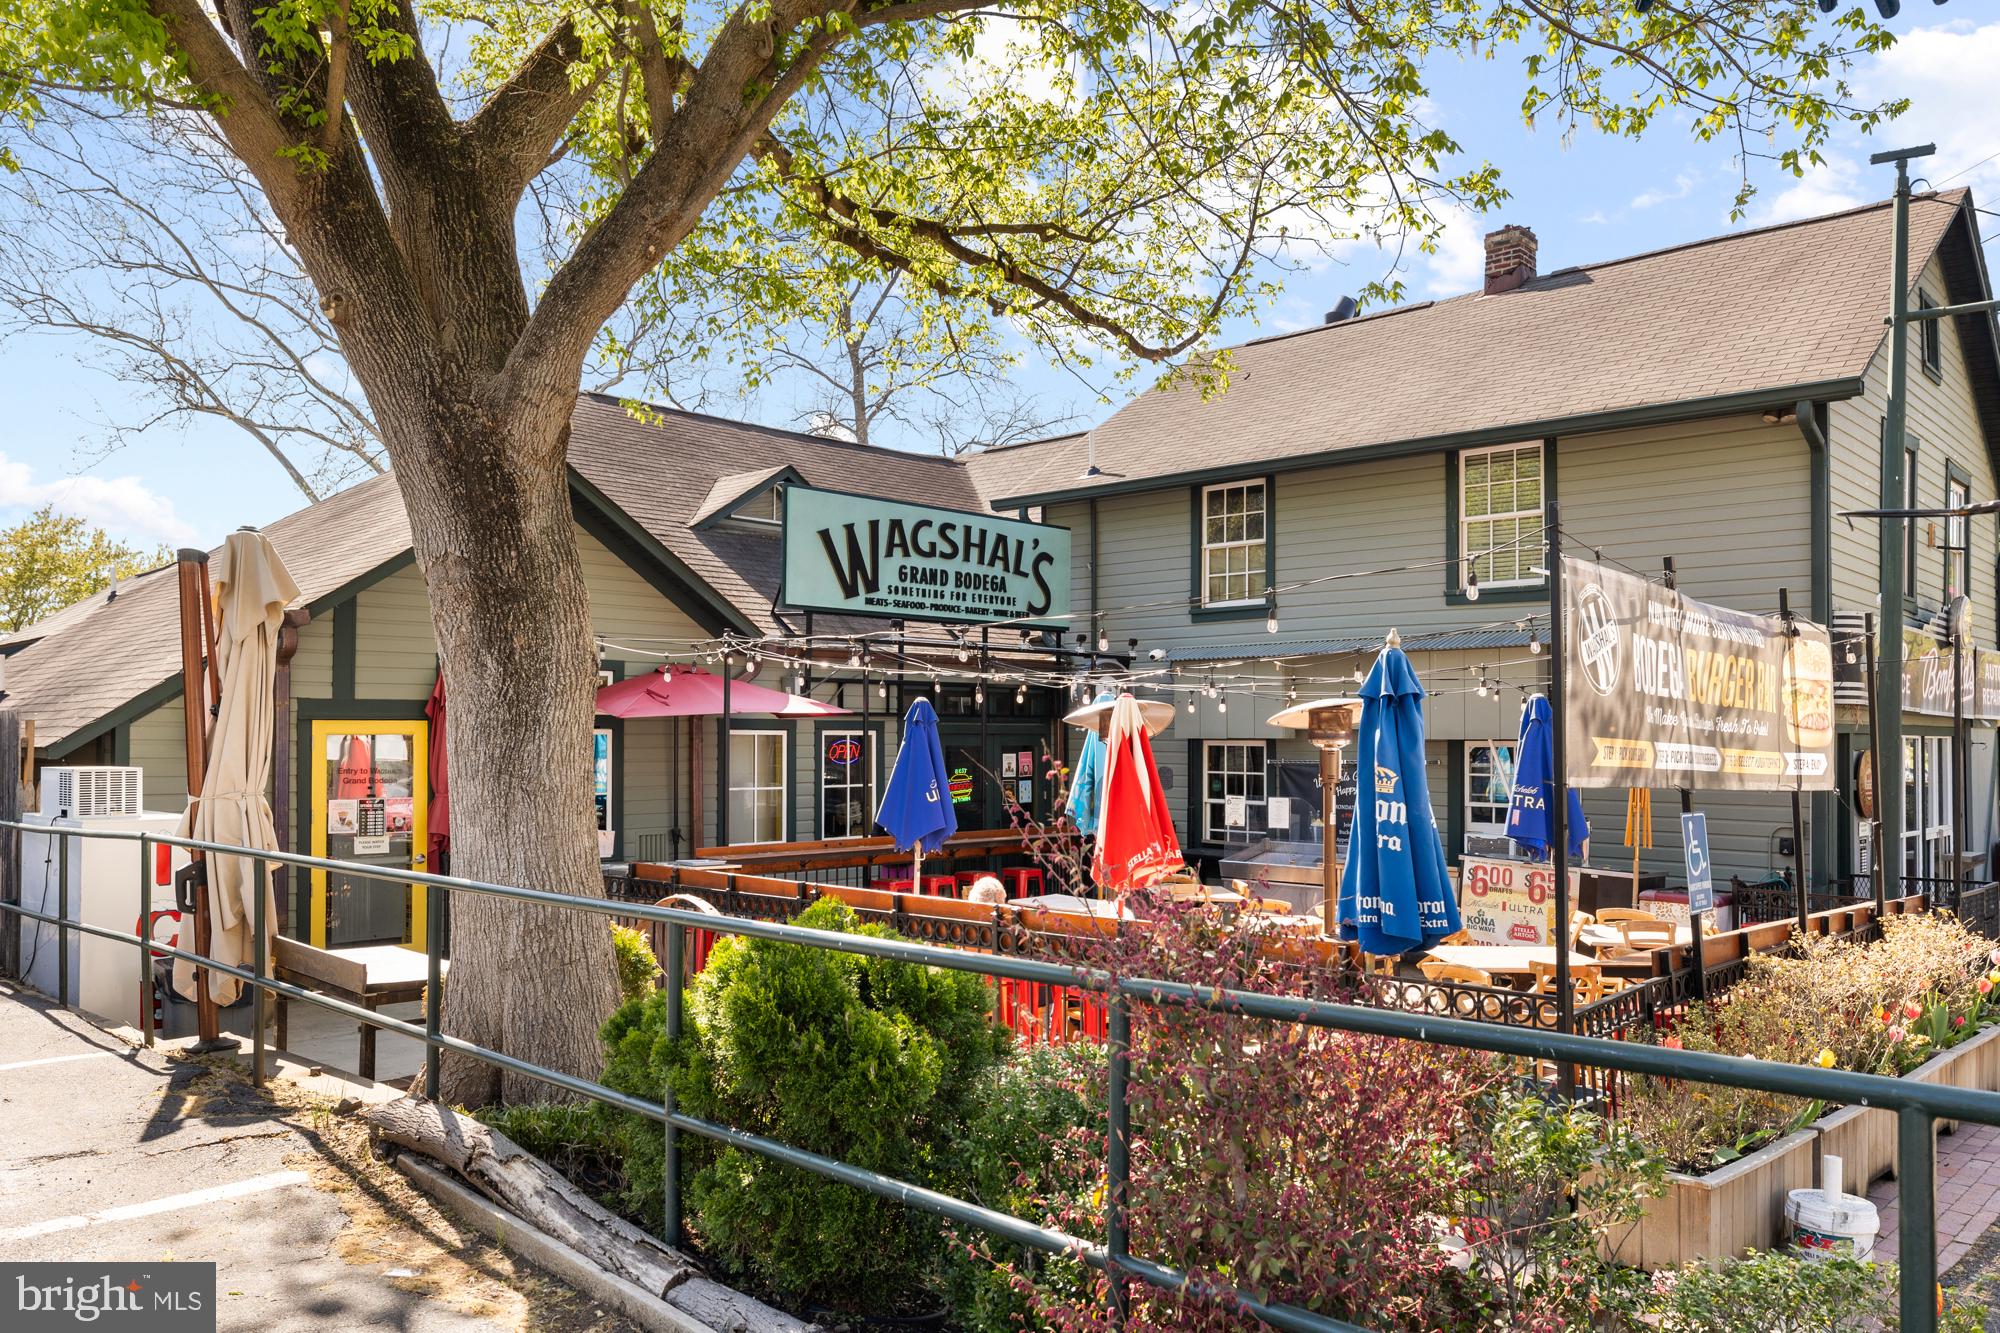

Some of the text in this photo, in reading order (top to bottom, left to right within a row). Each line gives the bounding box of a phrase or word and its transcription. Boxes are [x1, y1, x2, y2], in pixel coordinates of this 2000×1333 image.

[816, 518, 1054, 616] WAGSHAL'S
[898, 565, 1007, 593] GRAND BODEGA
[887, 585, 1017, 606] SOMETHING FOR EVERYONE
[1683, 610, 1711, 637] MORE
[1632, 632, 1777, 714] BODEGA BURGER BAR
[1654, 707, 1679, 726] Make
[1715, 716, 1738, 733] Fresh
[1740, 719, 1752, 734] To
[828, 744, 860, 760] OPEN
[338, 767, 358, 776] Entry
[1336, 785, 1358, 797] Happy
[1512, 794, 1546, 811] TRA
[1127, 847, 1154, 870] STELLA
[1488, 886, 1513, 895] DRAFTS
[1508, 904, 1544, 916] ULTRA
[1358, 914, 1378, 923] xtra
[1466, 915, 1496, 928] KONA
[1466, 923, 1496, 933] BIG WAVE
[1513, 931, 1535, 939] ARTOIS
[1514, 926, 1535, 934] STELLA
